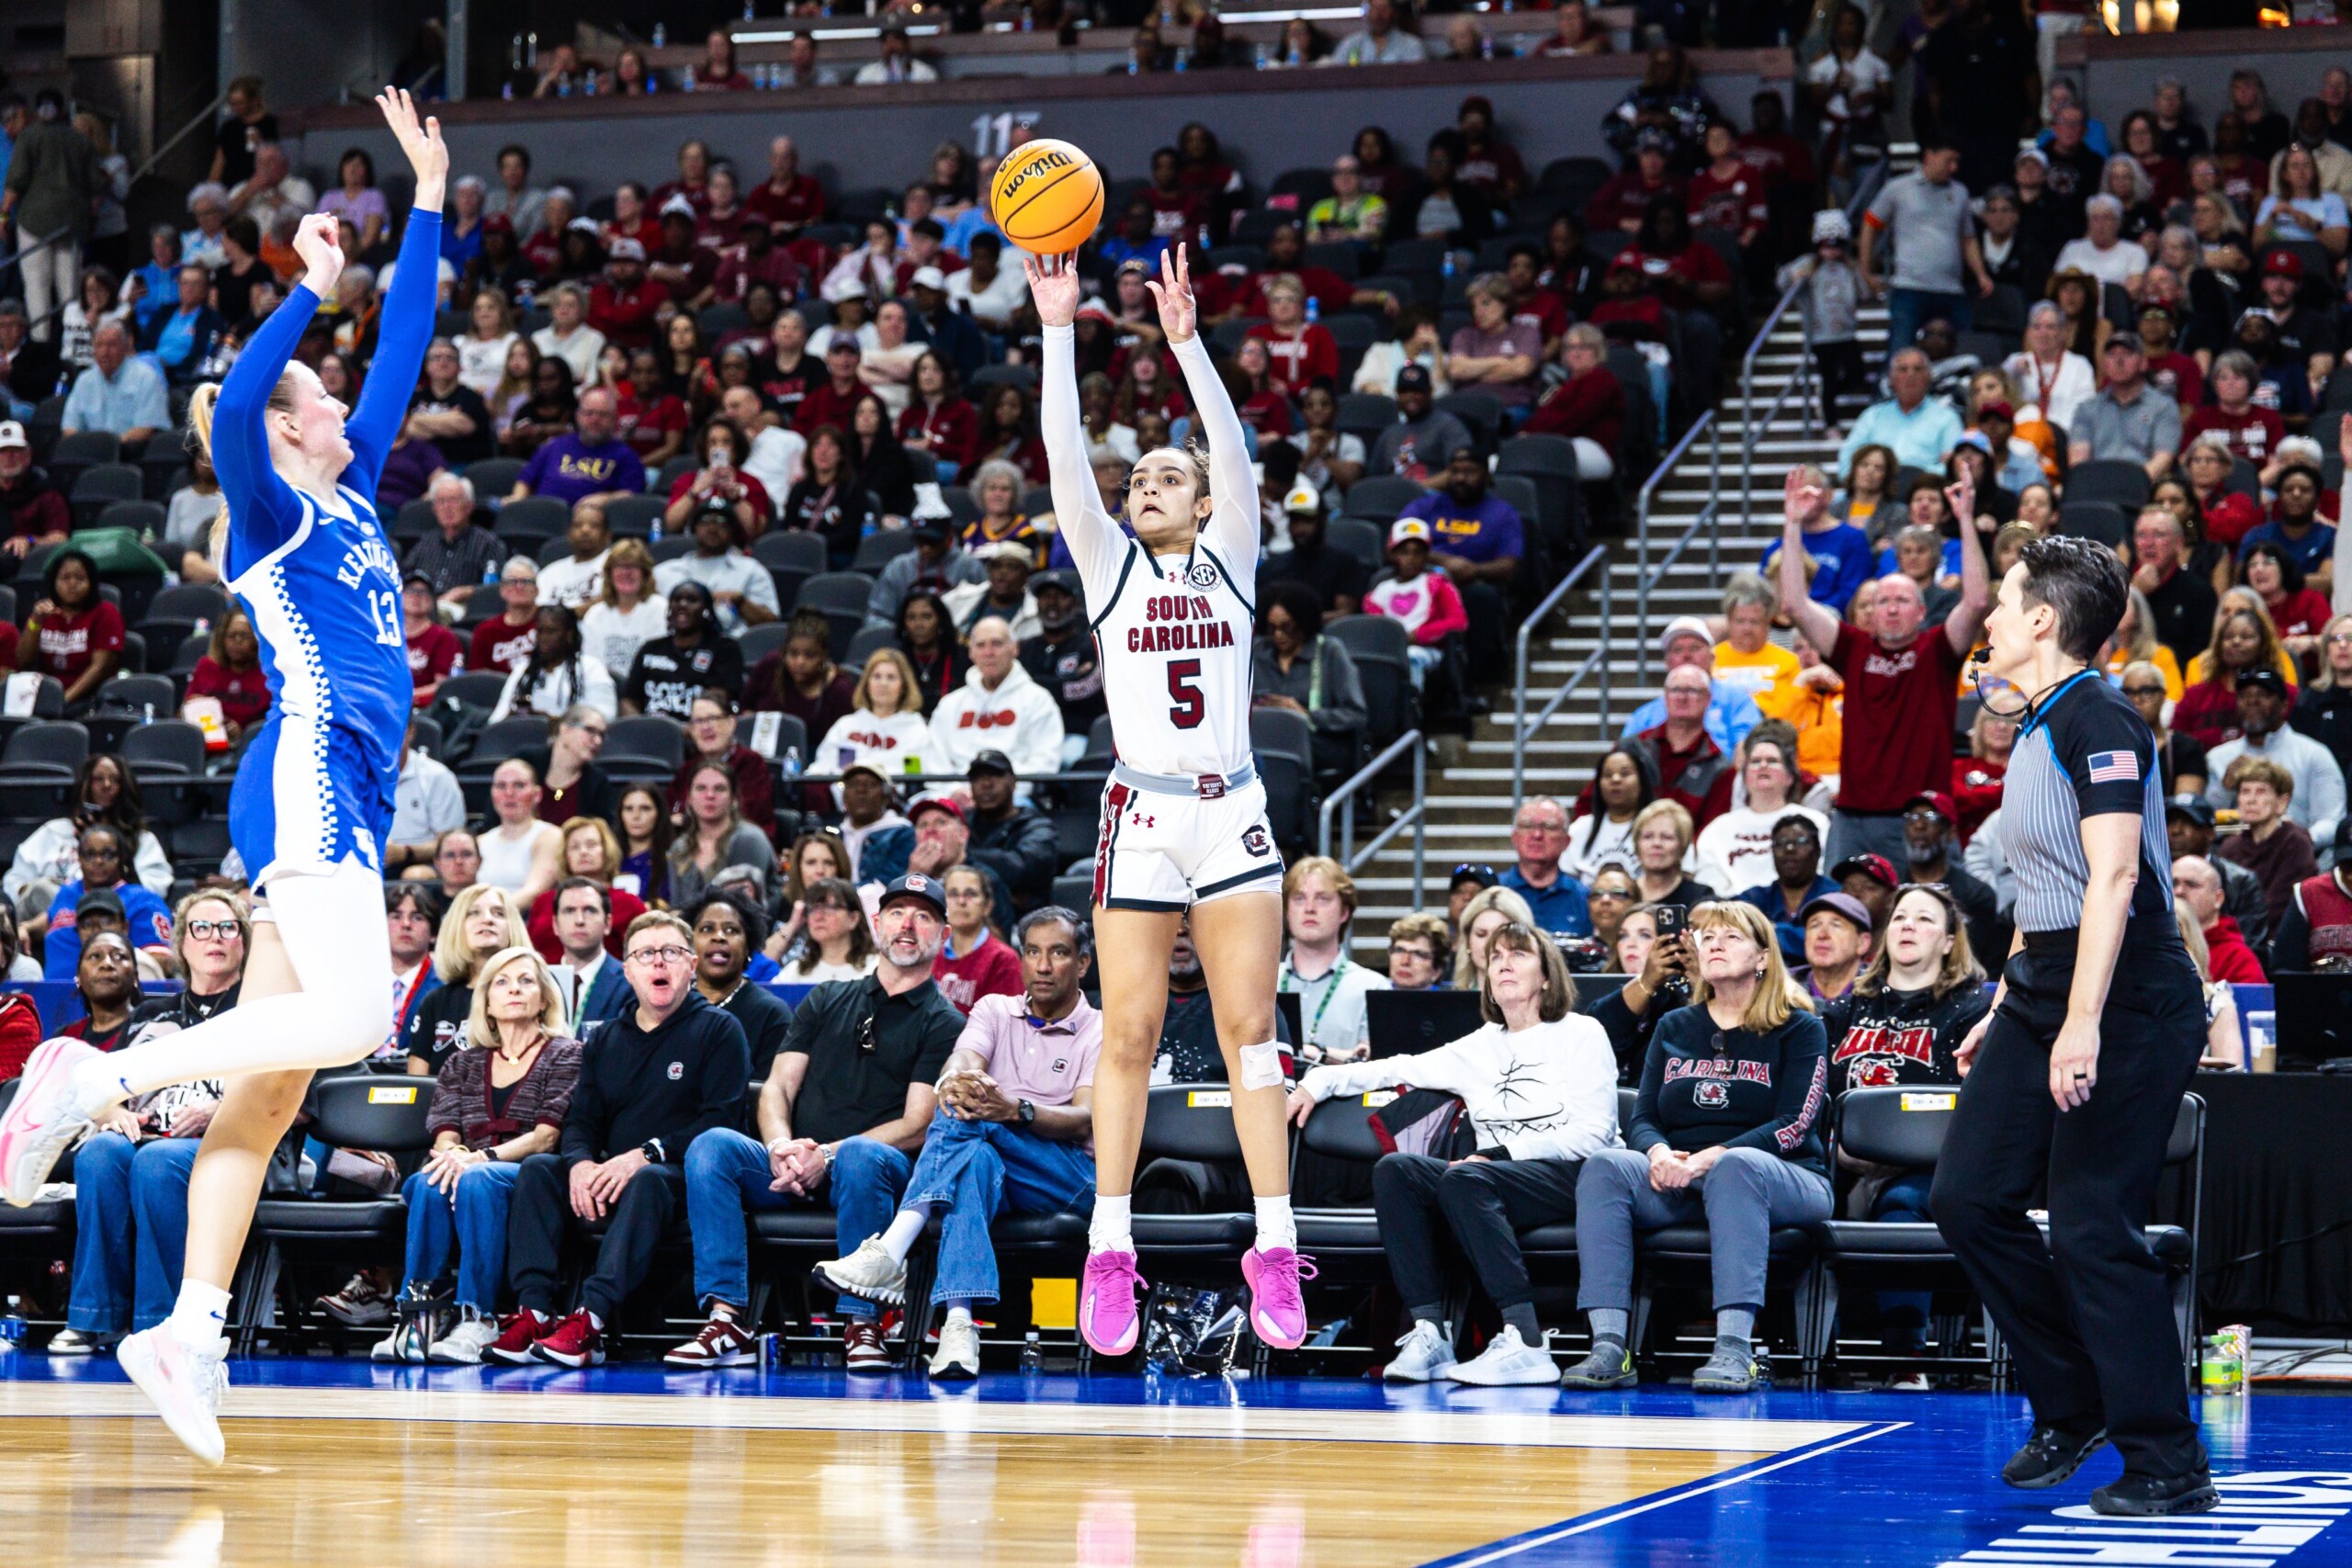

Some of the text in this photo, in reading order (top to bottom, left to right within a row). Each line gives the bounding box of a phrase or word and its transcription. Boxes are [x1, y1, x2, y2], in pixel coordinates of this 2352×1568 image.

[1003, 150, 1074, 198] Wilson
[1193, 564, 1216, 585] SEC
[368, 589, 401, 647] 13
[1146, 595, 1214, 622] SOUTH
[1127, 620, 1235, 653] CAROLINA
[1167, 658, 1204, 729] 5
[1664, 1056, 1771, 1088] CAROLINA
[1934, 1471, 2352, 1568] SOUTH
